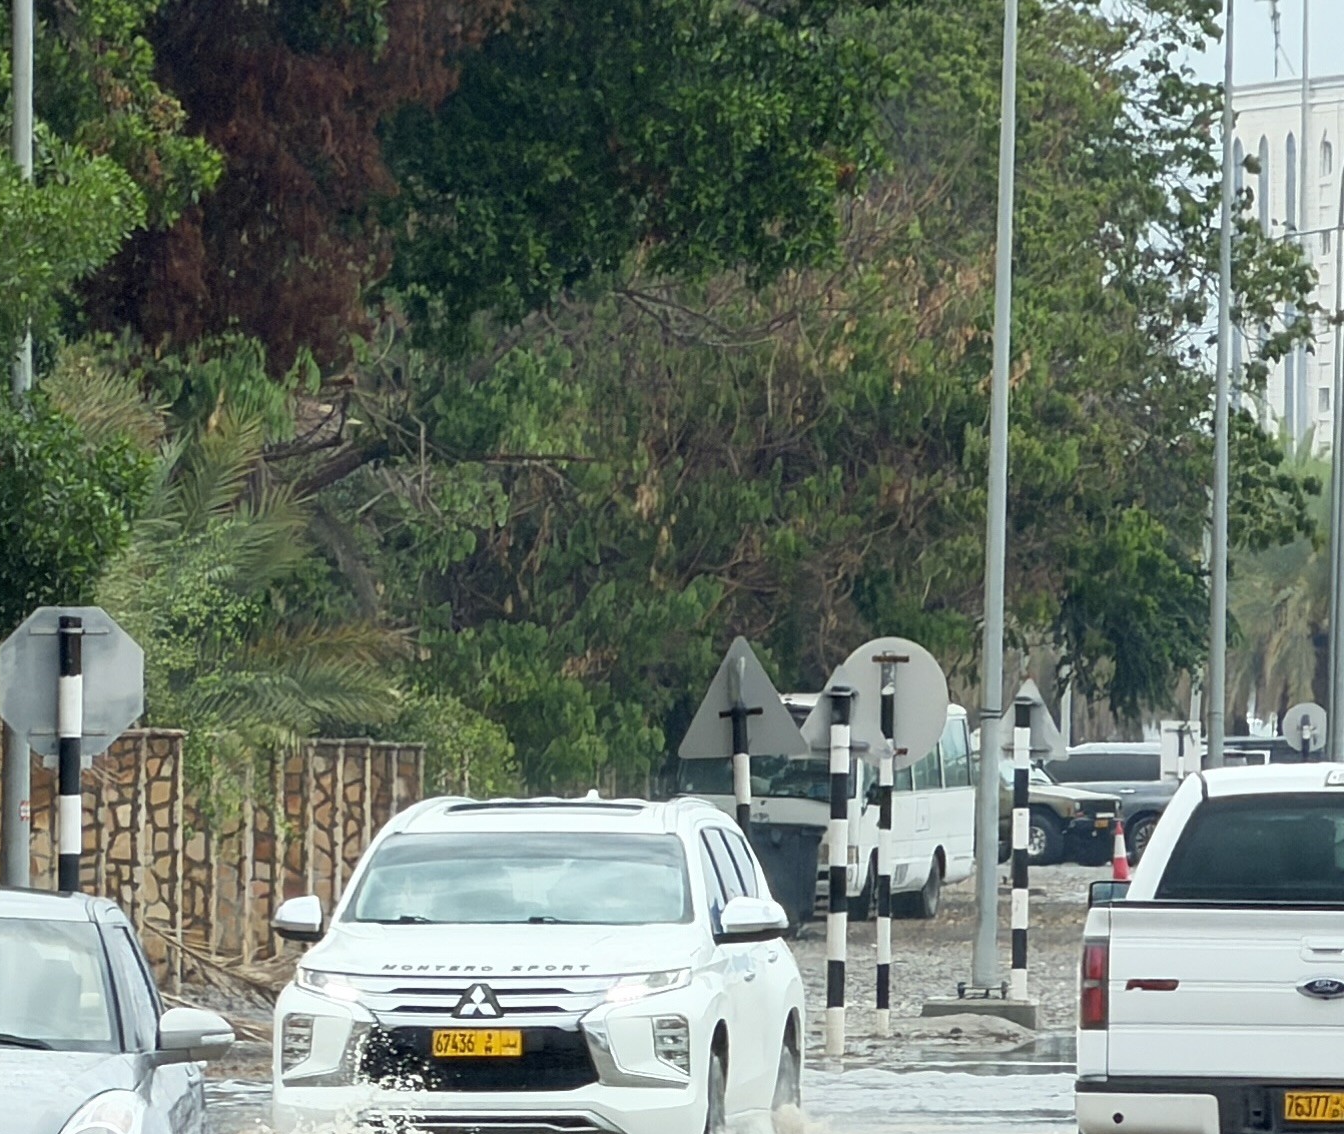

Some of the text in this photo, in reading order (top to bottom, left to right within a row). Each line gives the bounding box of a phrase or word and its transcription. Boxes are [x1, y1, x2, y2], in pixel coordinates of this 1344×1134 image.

[382, 964, 591, 972] MONTERO SPORT
[435, 1034, 475, 1053] 67436
[1287, 1094, 1331, 1117] 76377
